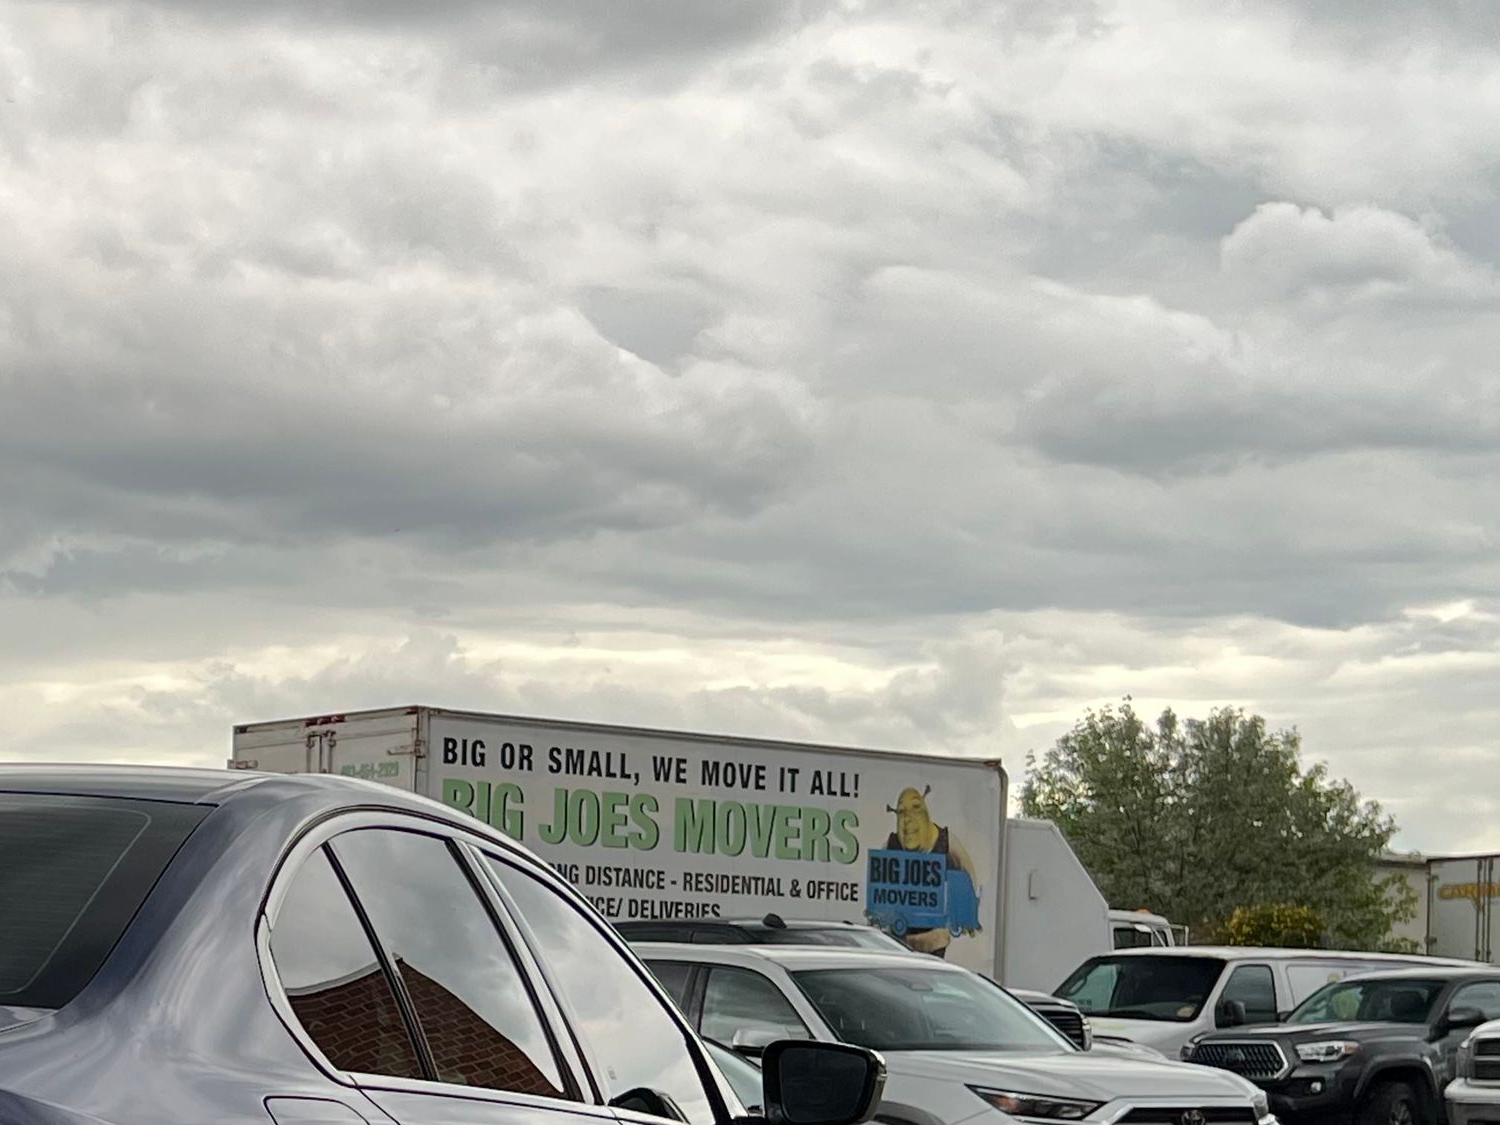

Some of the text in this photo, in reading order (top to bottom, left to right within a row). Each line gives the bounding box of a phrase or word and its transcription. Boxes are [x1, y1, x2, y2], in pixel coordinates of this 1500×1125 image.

[443, 737, 859, 798] BIG OR SMALL, WE MOVE IT ALL!
[442, 778, 860, 865] BIG JOES MOVERS
[585, 865, 665, 890] DISTANCE
[683, 872, 785, 897] RESIDENTIAL
[789, 879, 801, 898] &
[806, 880, 859, 902] OFFICE
[870, 857, 942, 887] BIG JOES
[628, 899, 721, 919] DELIVERIES
[873, 888, 938, 908] MOVERS
